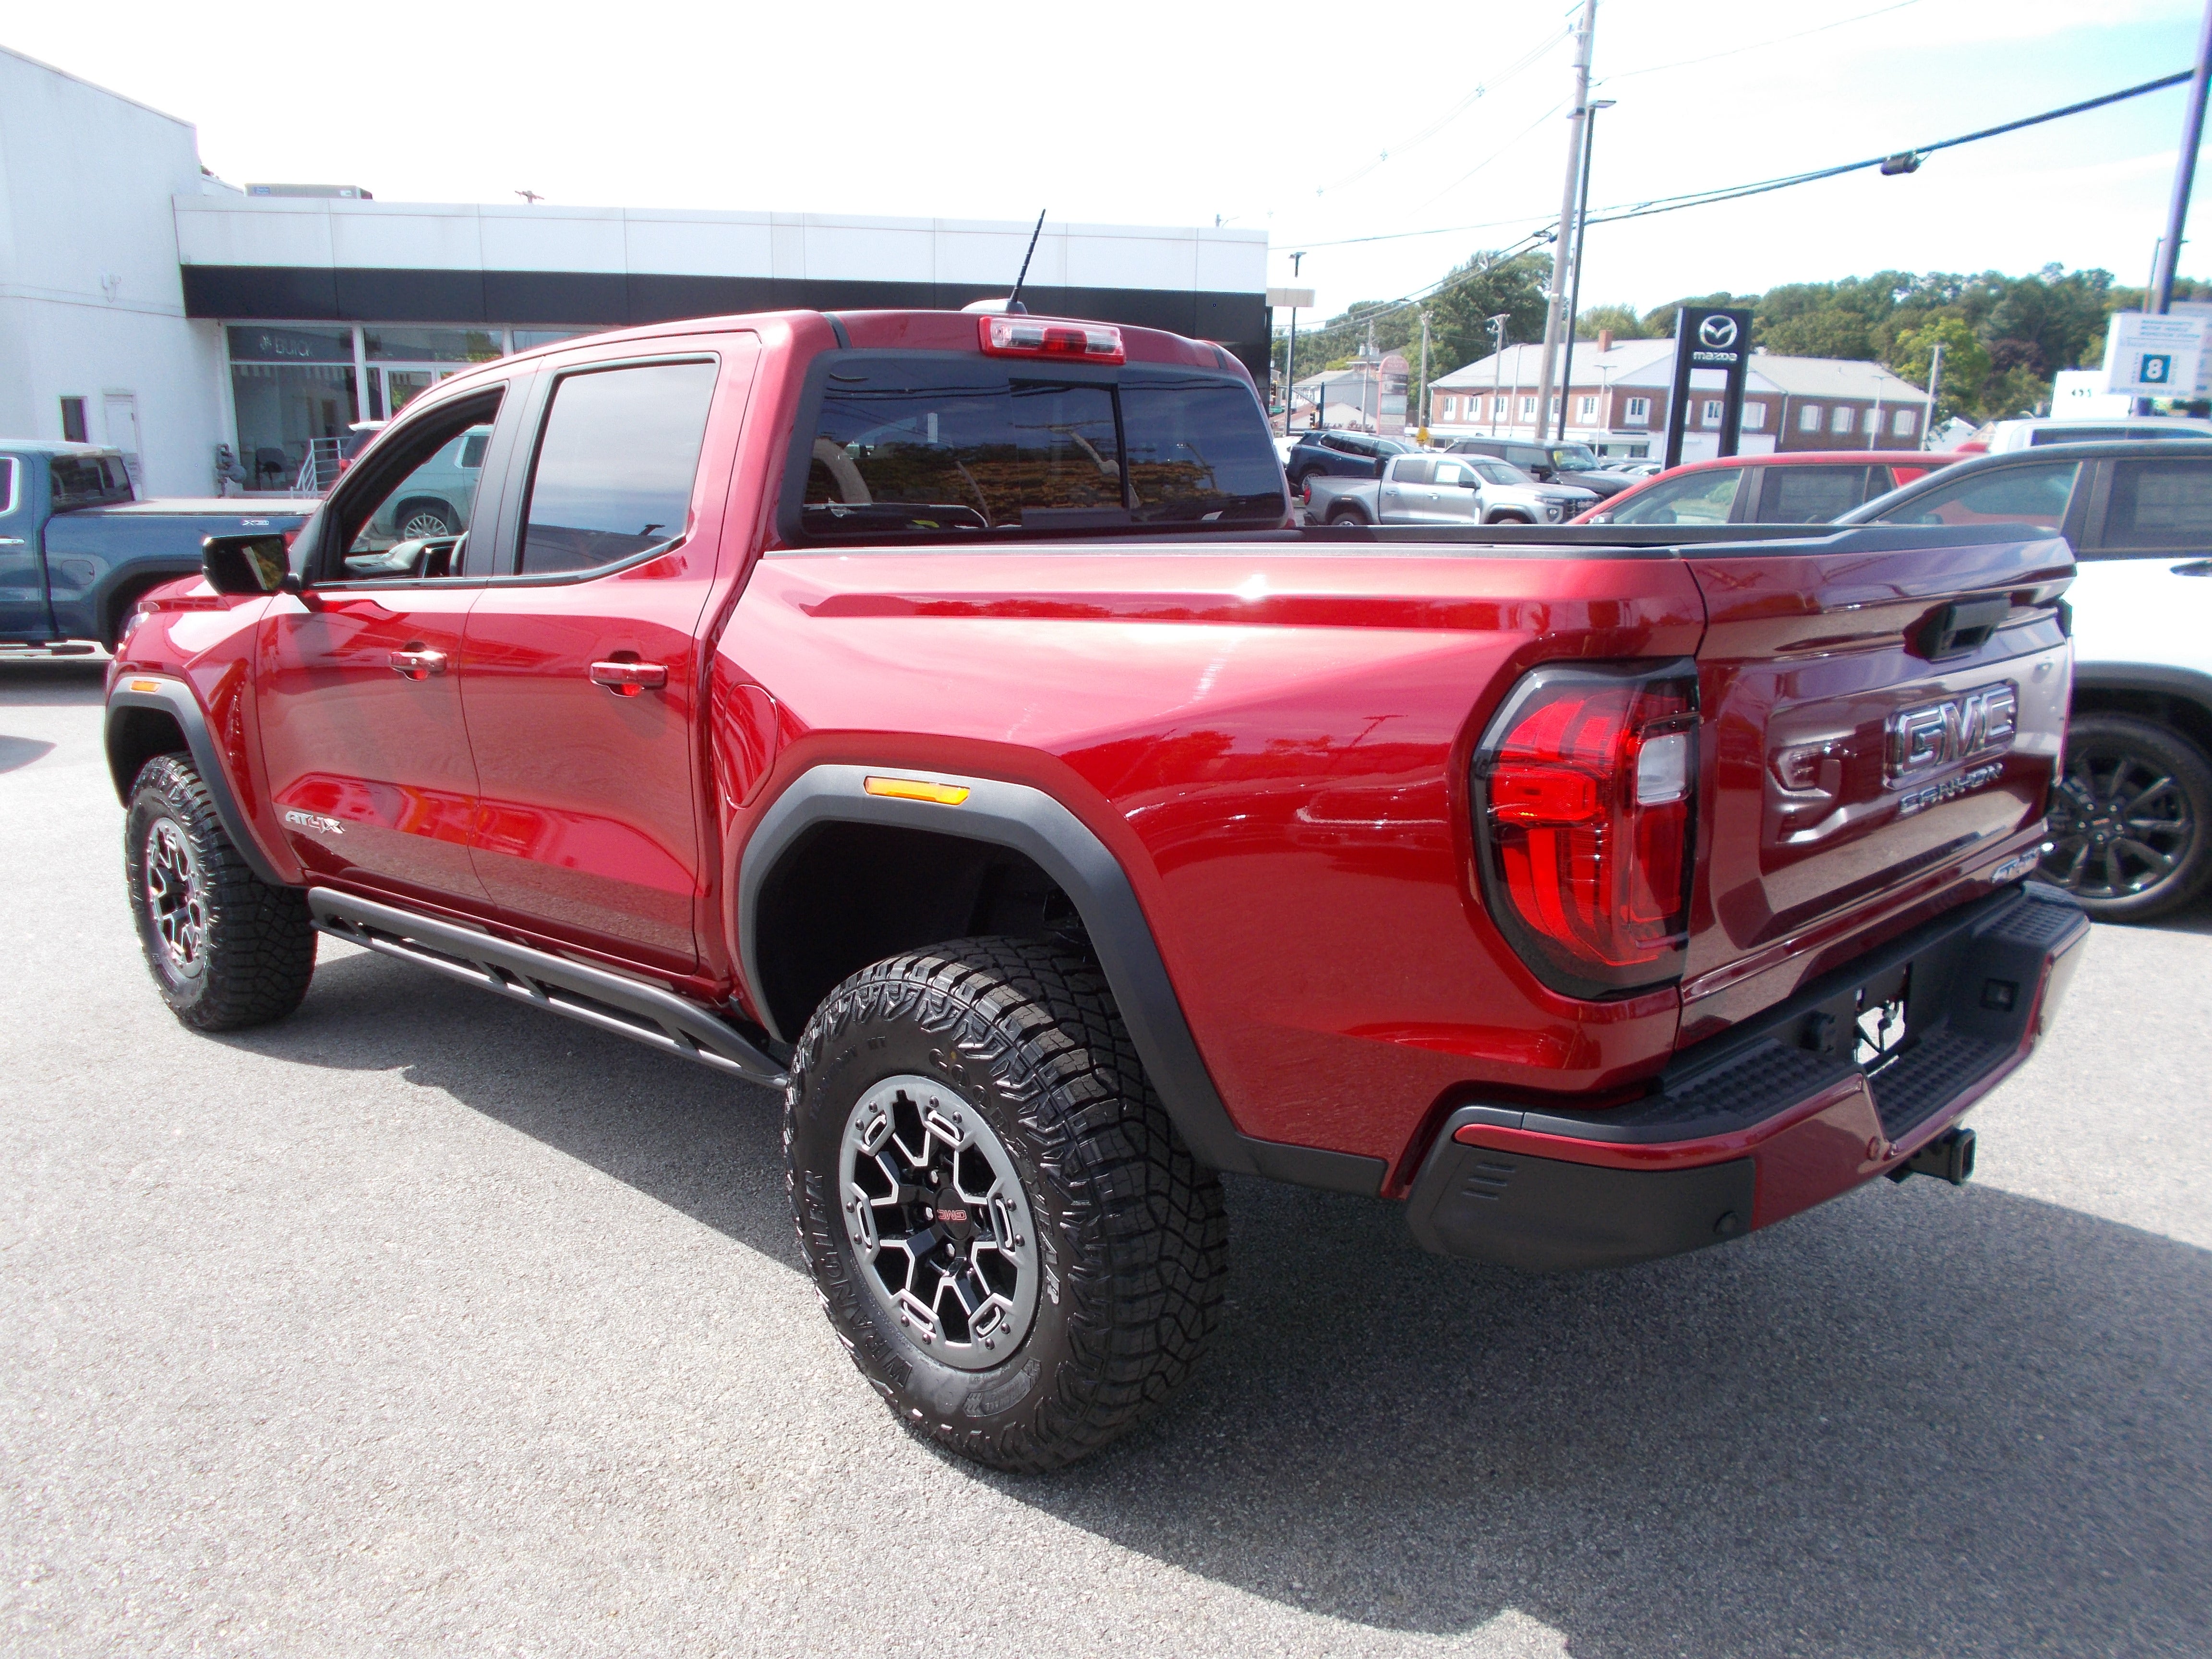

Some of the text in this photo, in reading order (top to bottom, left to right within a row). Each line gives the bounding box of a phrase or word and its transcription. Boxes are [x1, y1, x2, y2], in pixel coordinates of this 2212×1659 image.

[2147, 358, 2164, 379] 8
[1896, 685, 2016, 774] GMC
[1899, 762, 2003, 814] CANYON
[285, 810, 346, 834] AT4X
[929, 1048, 1060, 1305] GOODYEAR
[937, 1209, 967, 1221] GMC
[804, 1169, 914, 1389] WRANGLER
